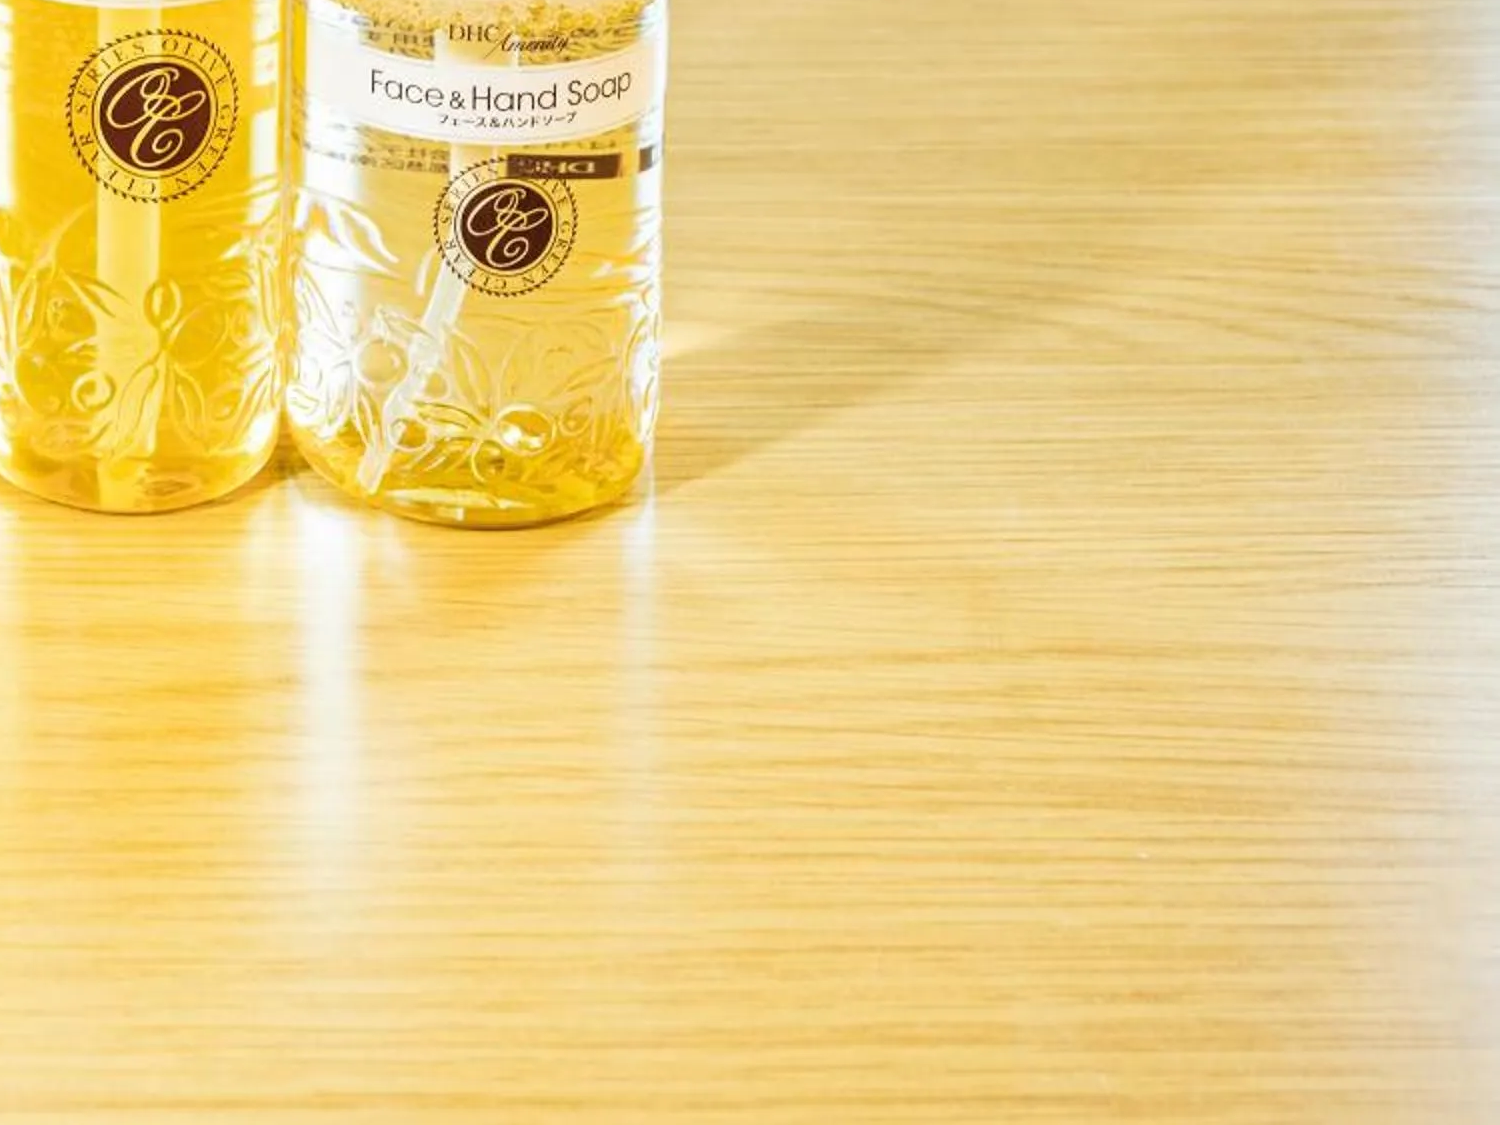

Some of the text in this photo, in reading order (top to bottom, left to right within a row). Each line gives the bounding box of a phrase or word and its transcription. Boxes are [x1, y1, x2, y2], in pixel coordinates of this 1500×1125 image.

[449, 24, 500, 43] DHC
[371, 68, 632, 112] Face & Hand Soap
